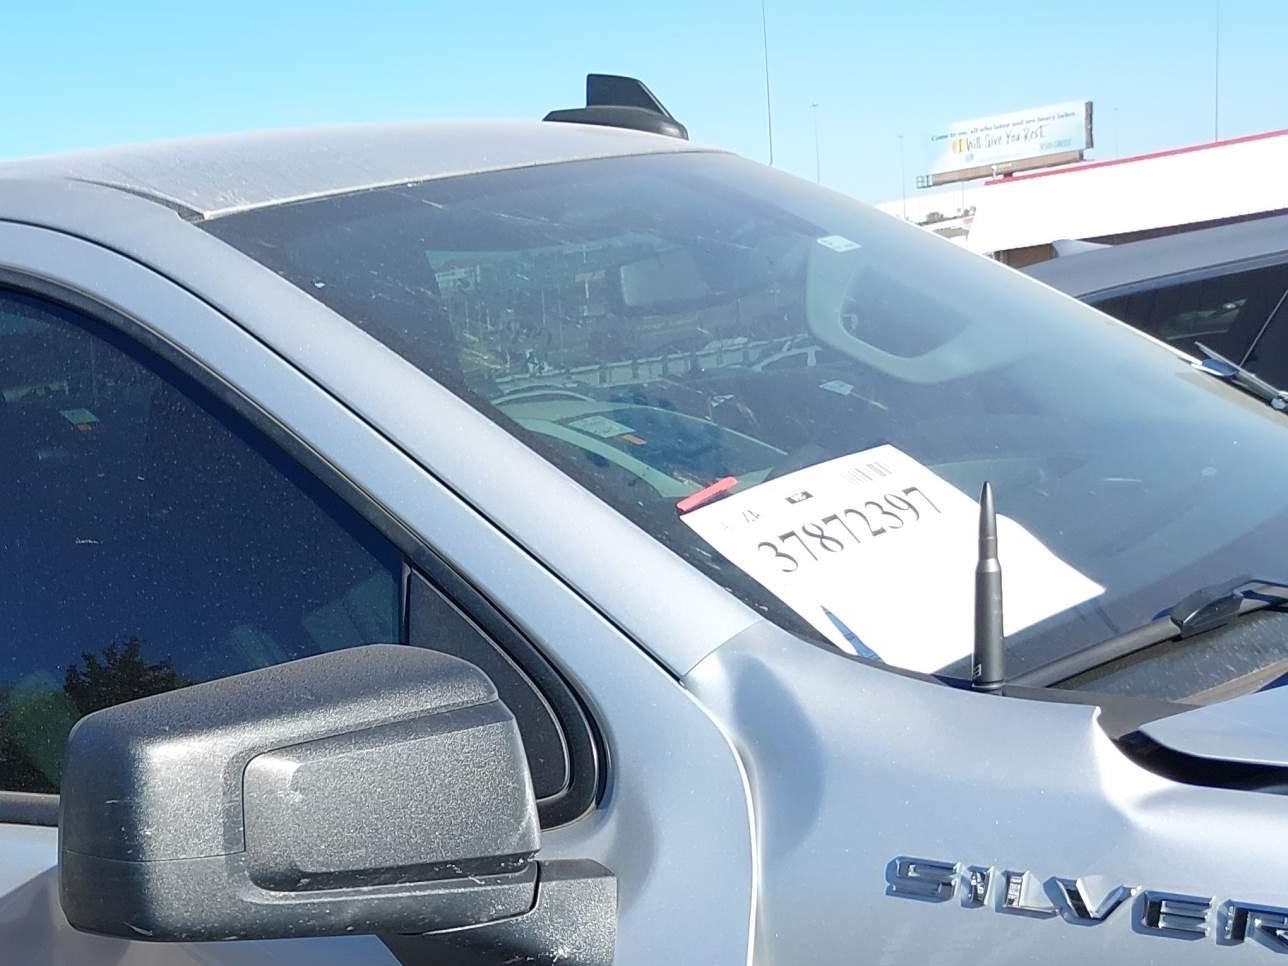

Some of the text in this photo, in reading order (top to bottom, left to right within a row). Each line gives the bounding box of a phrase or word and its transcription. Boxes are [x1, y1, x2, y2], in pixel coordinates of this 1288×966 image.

[966, 135, 981, 151] Will
[984, 133, 1002, 149] Give
[1005, 130, 1021, 145] You
[1023, 124, 1048, 143] Rest
[758, 487, 941, 574] 37872397
